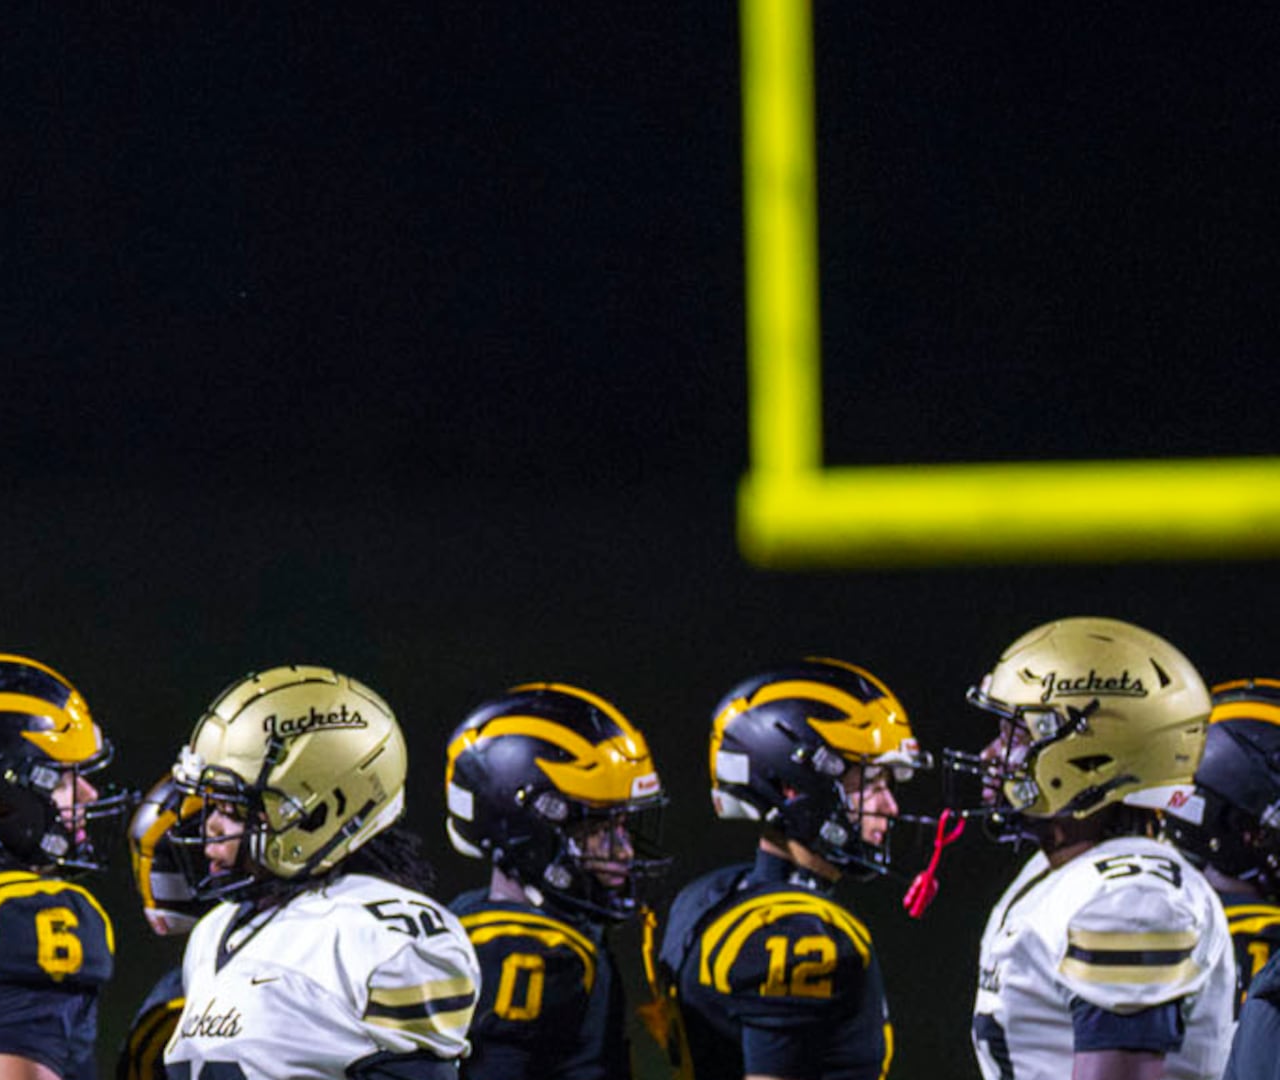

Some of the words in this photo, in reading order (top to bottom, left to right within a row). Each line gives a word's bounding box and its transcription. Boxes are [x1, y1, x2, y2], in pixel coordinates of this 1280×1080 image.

[1040, 669, 1149, 703] Jackets
[263, 703, 369, 746] Jackets
[1094, 854, 1182, 889] 53
[362, 899, 452, 938] 52
[35, 907, 83, 981] 6
[759, 934, 838, 998] 12
